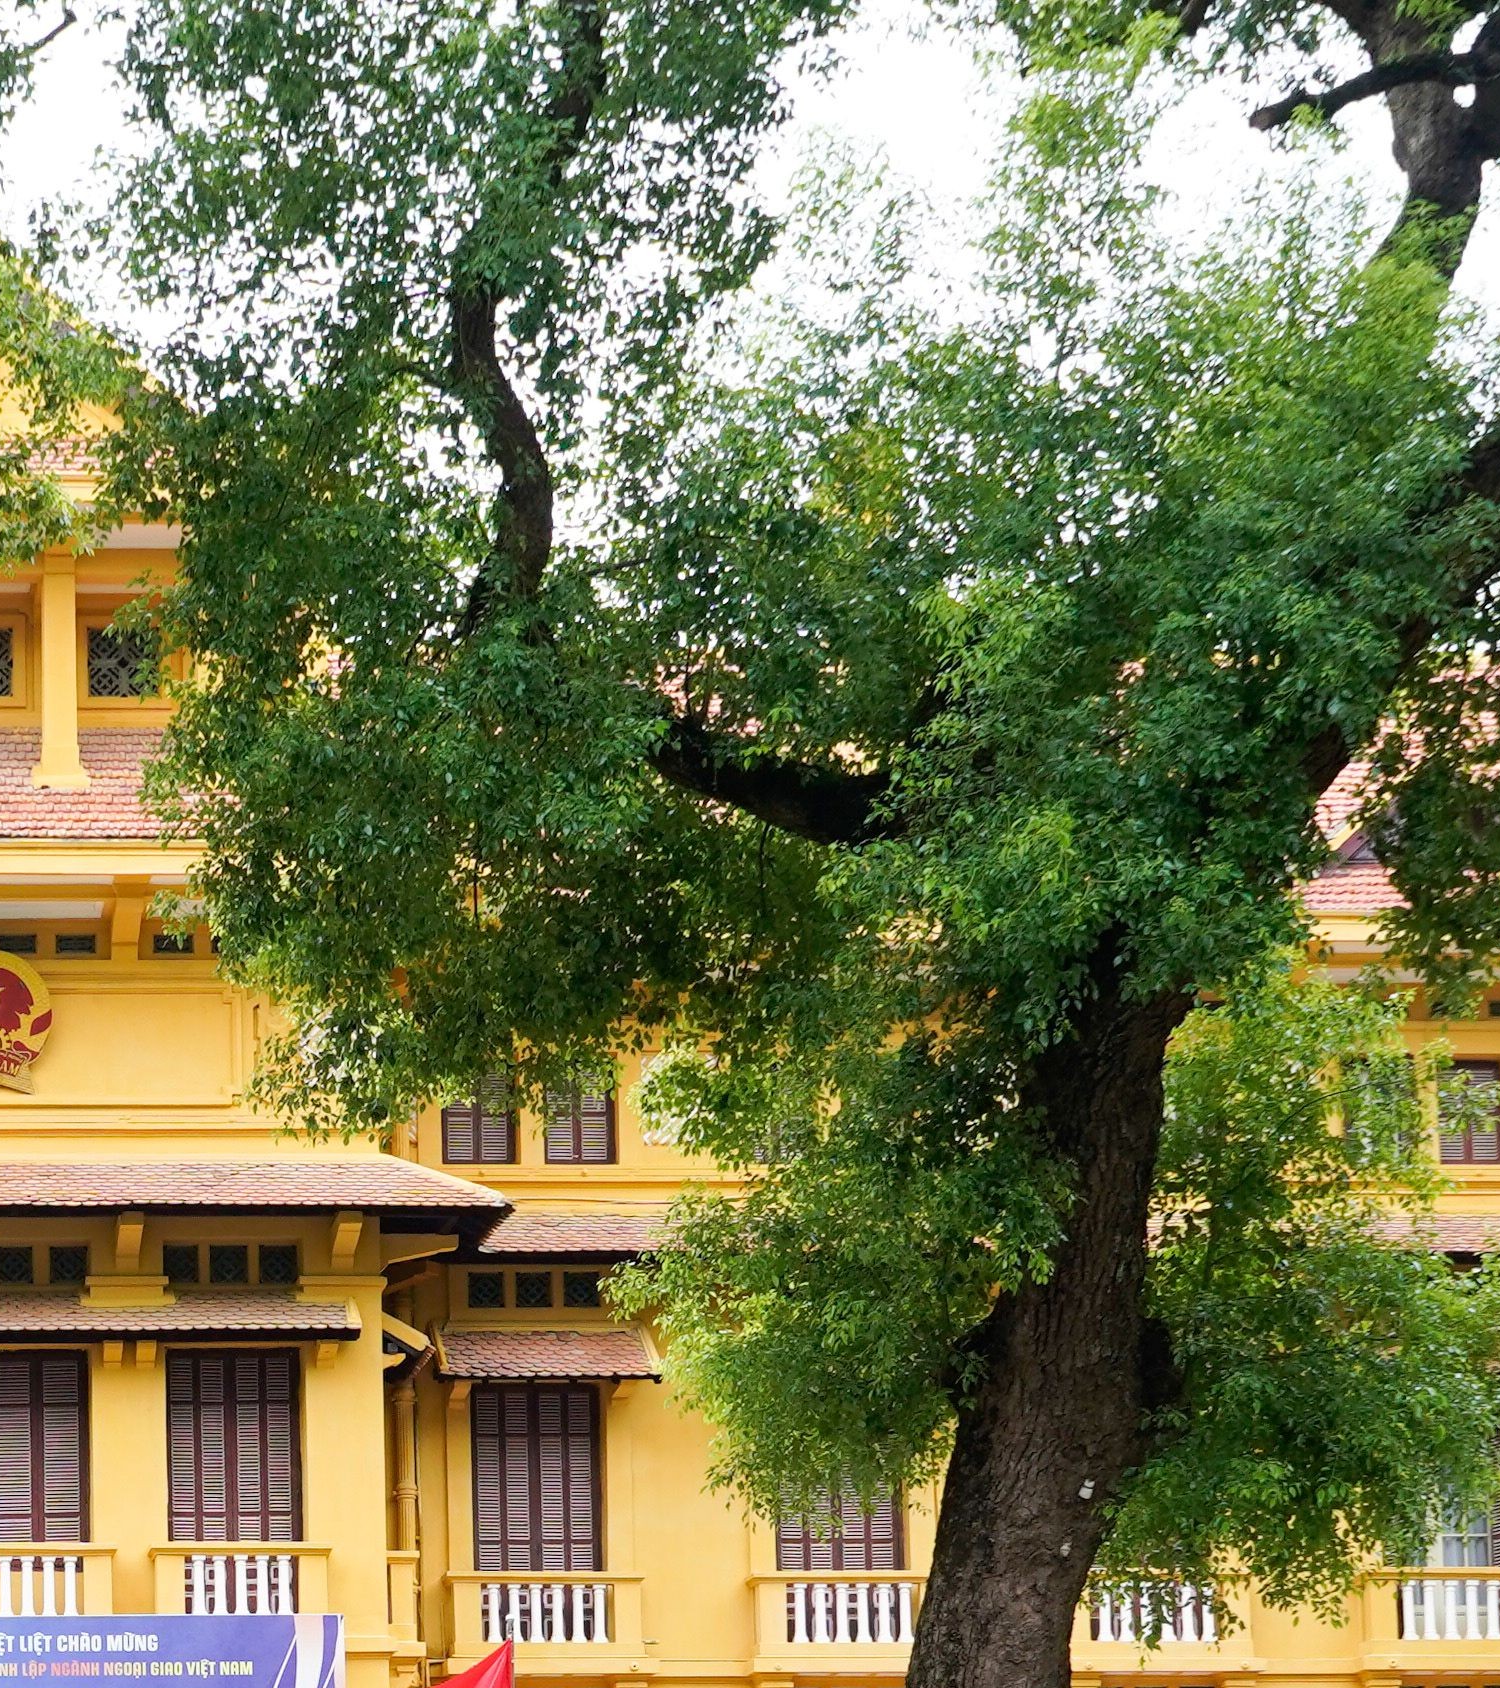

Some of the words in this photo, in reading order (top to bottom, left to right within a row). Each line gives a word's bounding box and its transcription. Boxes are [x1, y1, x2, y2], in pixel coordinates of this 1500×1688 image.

[19, 1632, 53, 1656] LIỆT
[56, 1632, 102, 1652] CHÀO
[106, 1631, 159, 1652] MỪNG
[22, 1659, 47, 1679] LẬP
[51, 1660, 100, 1677] NGÀNH
[104, 1661, 147, 1679] NGOẠI
[150, 1661, 183, 1677] GIAO
[186, 1658, 217, 1679] VIỆT
[220, 1661, 254, 1676] NAM
